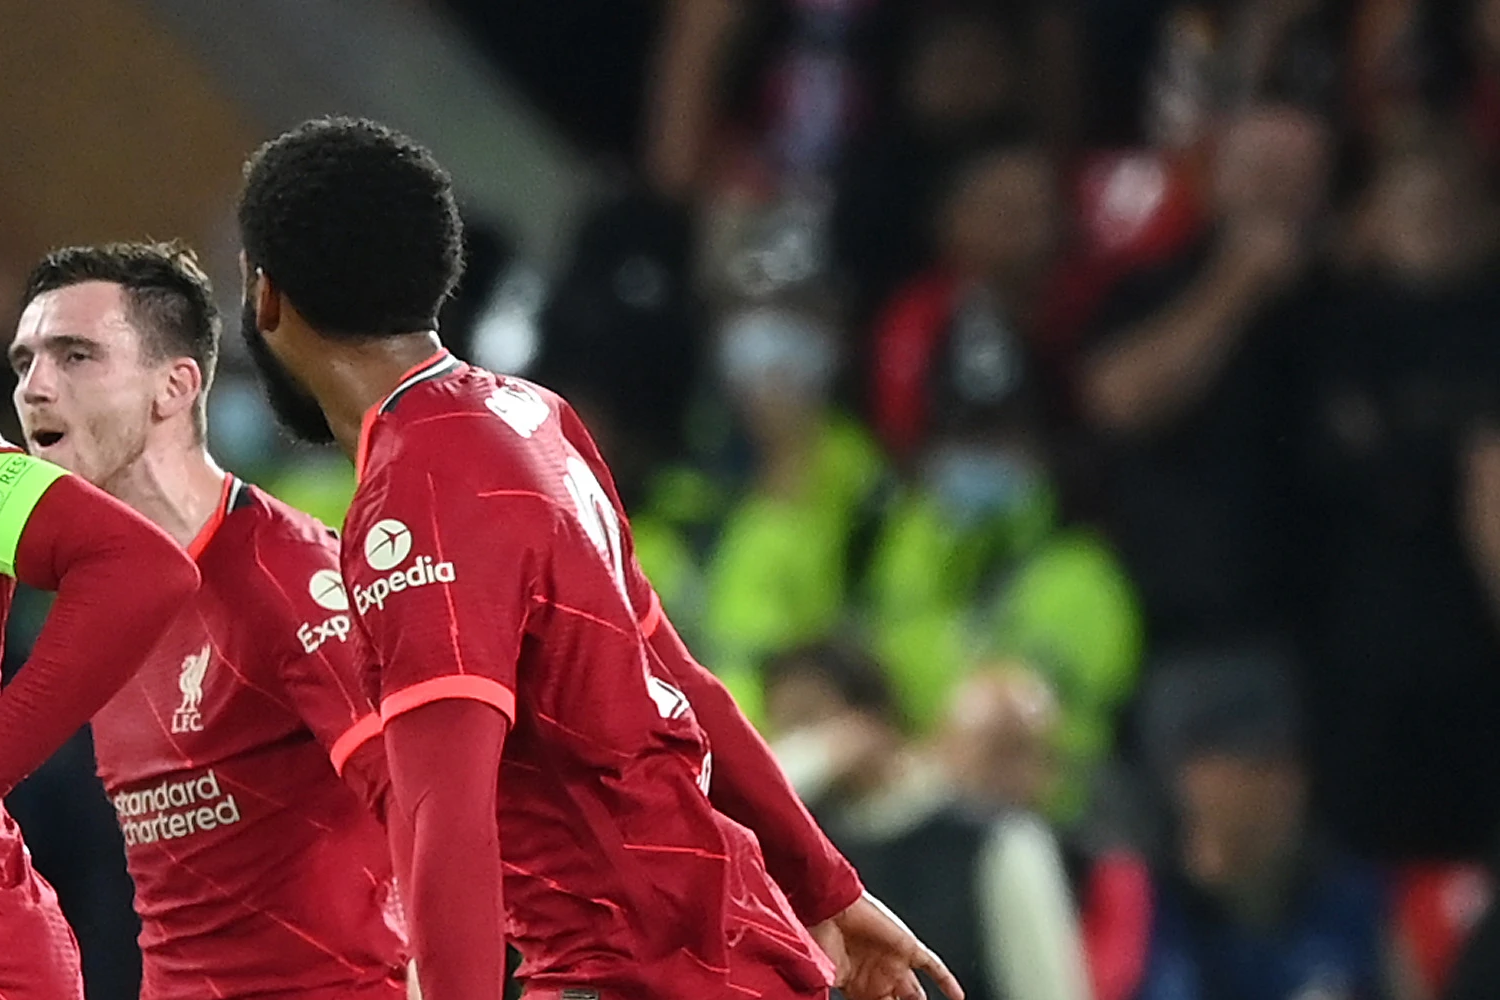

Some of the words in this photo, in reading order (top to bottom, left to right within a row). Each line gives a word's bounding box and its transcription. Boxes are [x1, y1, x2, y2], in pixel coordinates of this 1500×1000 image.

[353, 555, 456, 616] Expedia
[296, 614, 350, 654] Exp
[113, 768, 220, 817] standard
[122, 793, 240, 846] chartered
